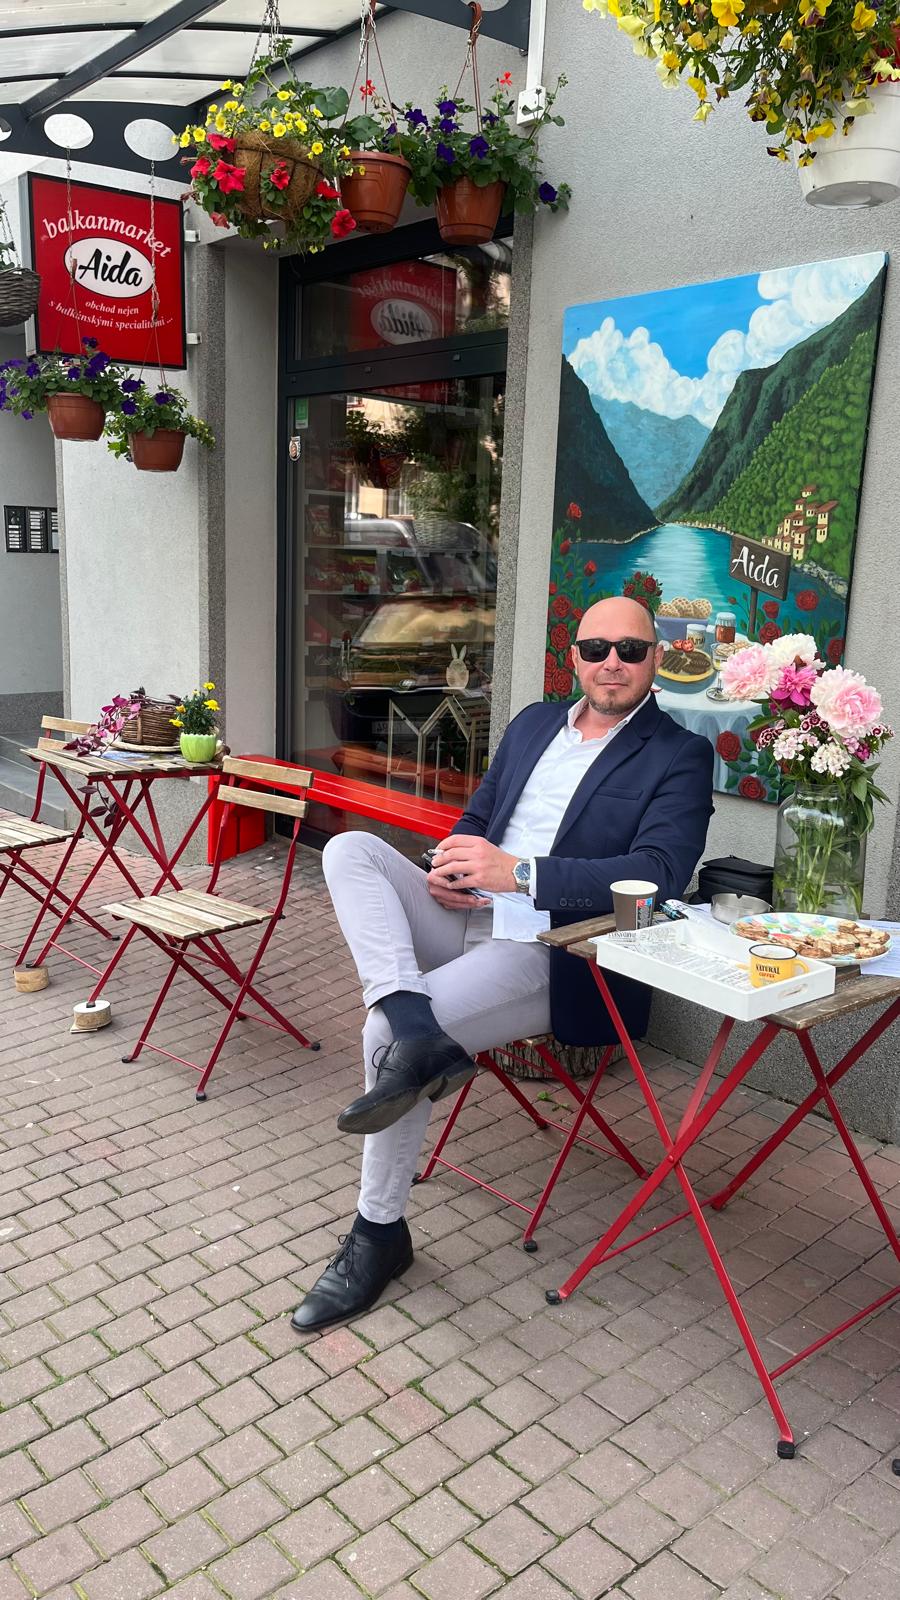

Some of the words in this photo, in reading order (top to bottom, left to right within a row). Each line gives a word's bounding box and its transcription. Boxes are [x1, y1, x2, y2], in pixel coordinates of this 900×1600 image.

[43, 209, 172, 258] balkanmarket
[78, 248, 143, 287] Aida
[56, 303, 113, 328] balkánskými
[85, 299, 115, 314] obchod
[117, 305, 139, 316] nejen
[730, 545, 780, 588] Aida
[755, 963, 780, 975] NATURAL
